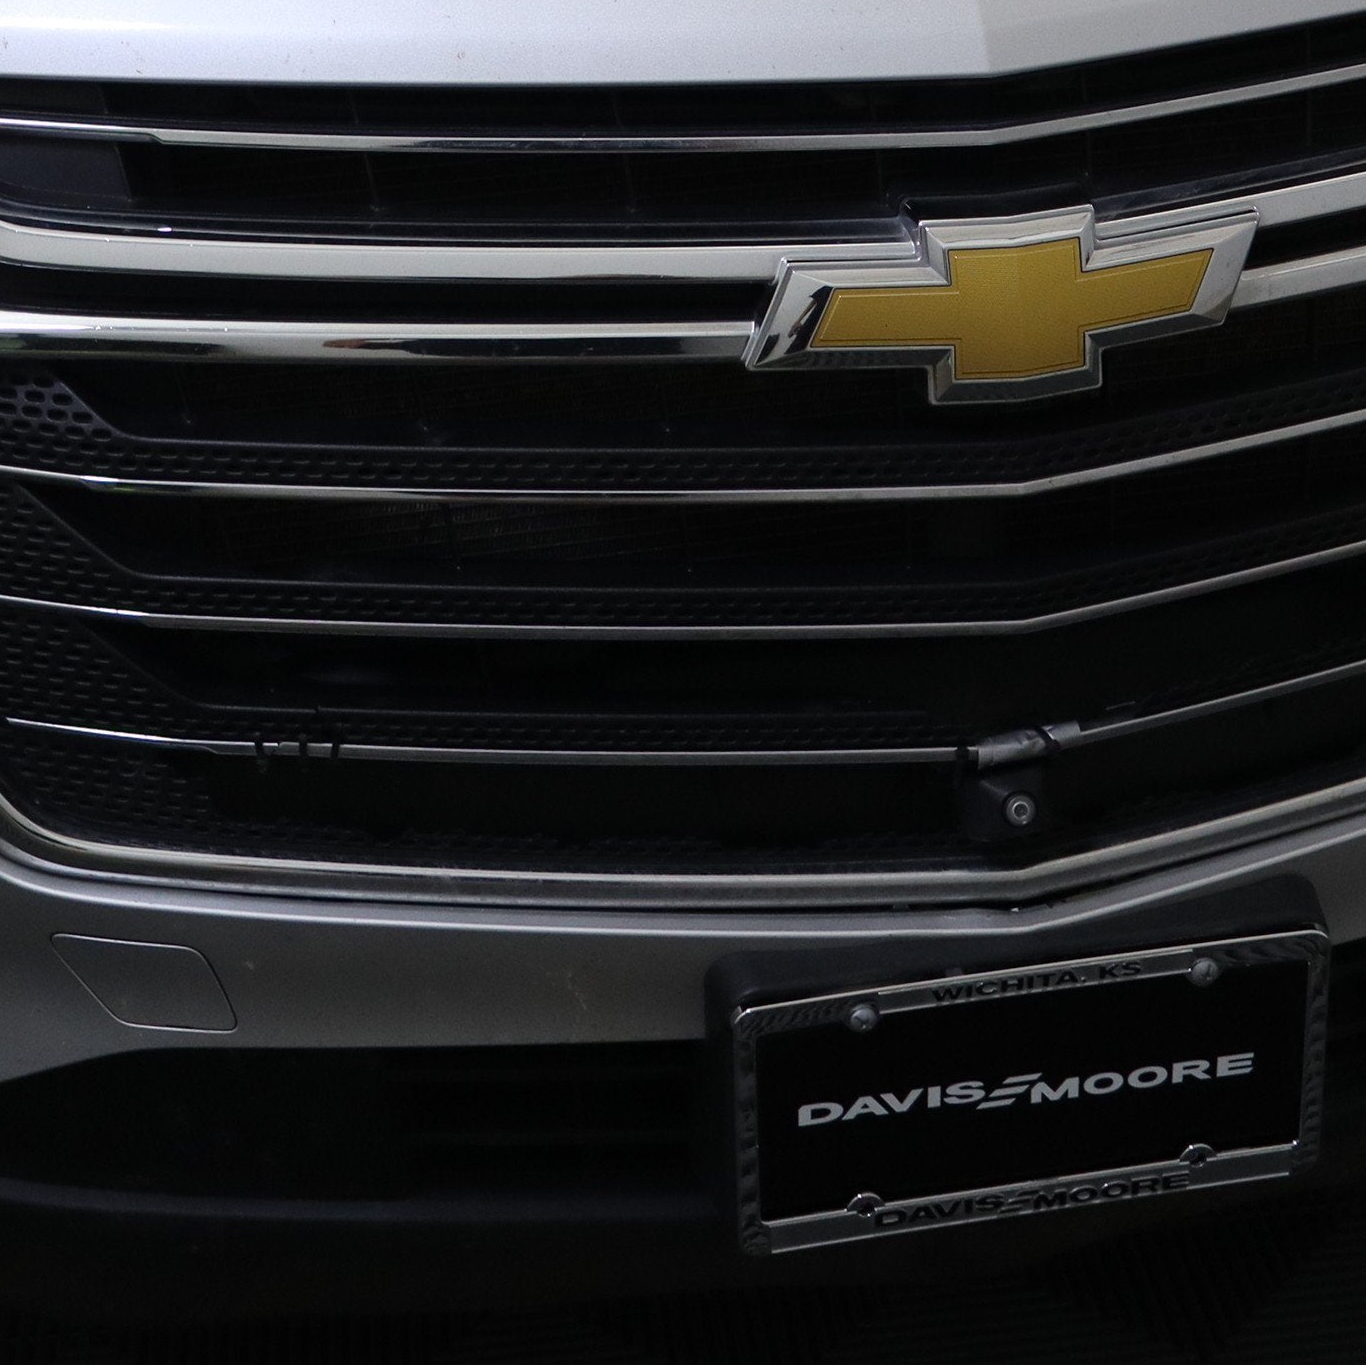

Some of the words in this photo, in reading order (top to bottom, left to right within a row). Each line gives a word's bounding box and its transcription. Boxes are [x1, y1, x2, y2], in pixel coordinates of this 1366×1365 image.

[1098, 960, 1142, 981] KS
[797, 1080, 983, 1126] DAVIS
[1031, 1053, 1255, 1104] MOORE
[875, 1195, 1006, 1228] DAVIS
[1033, 1171, 1190, 1211] MOORE
